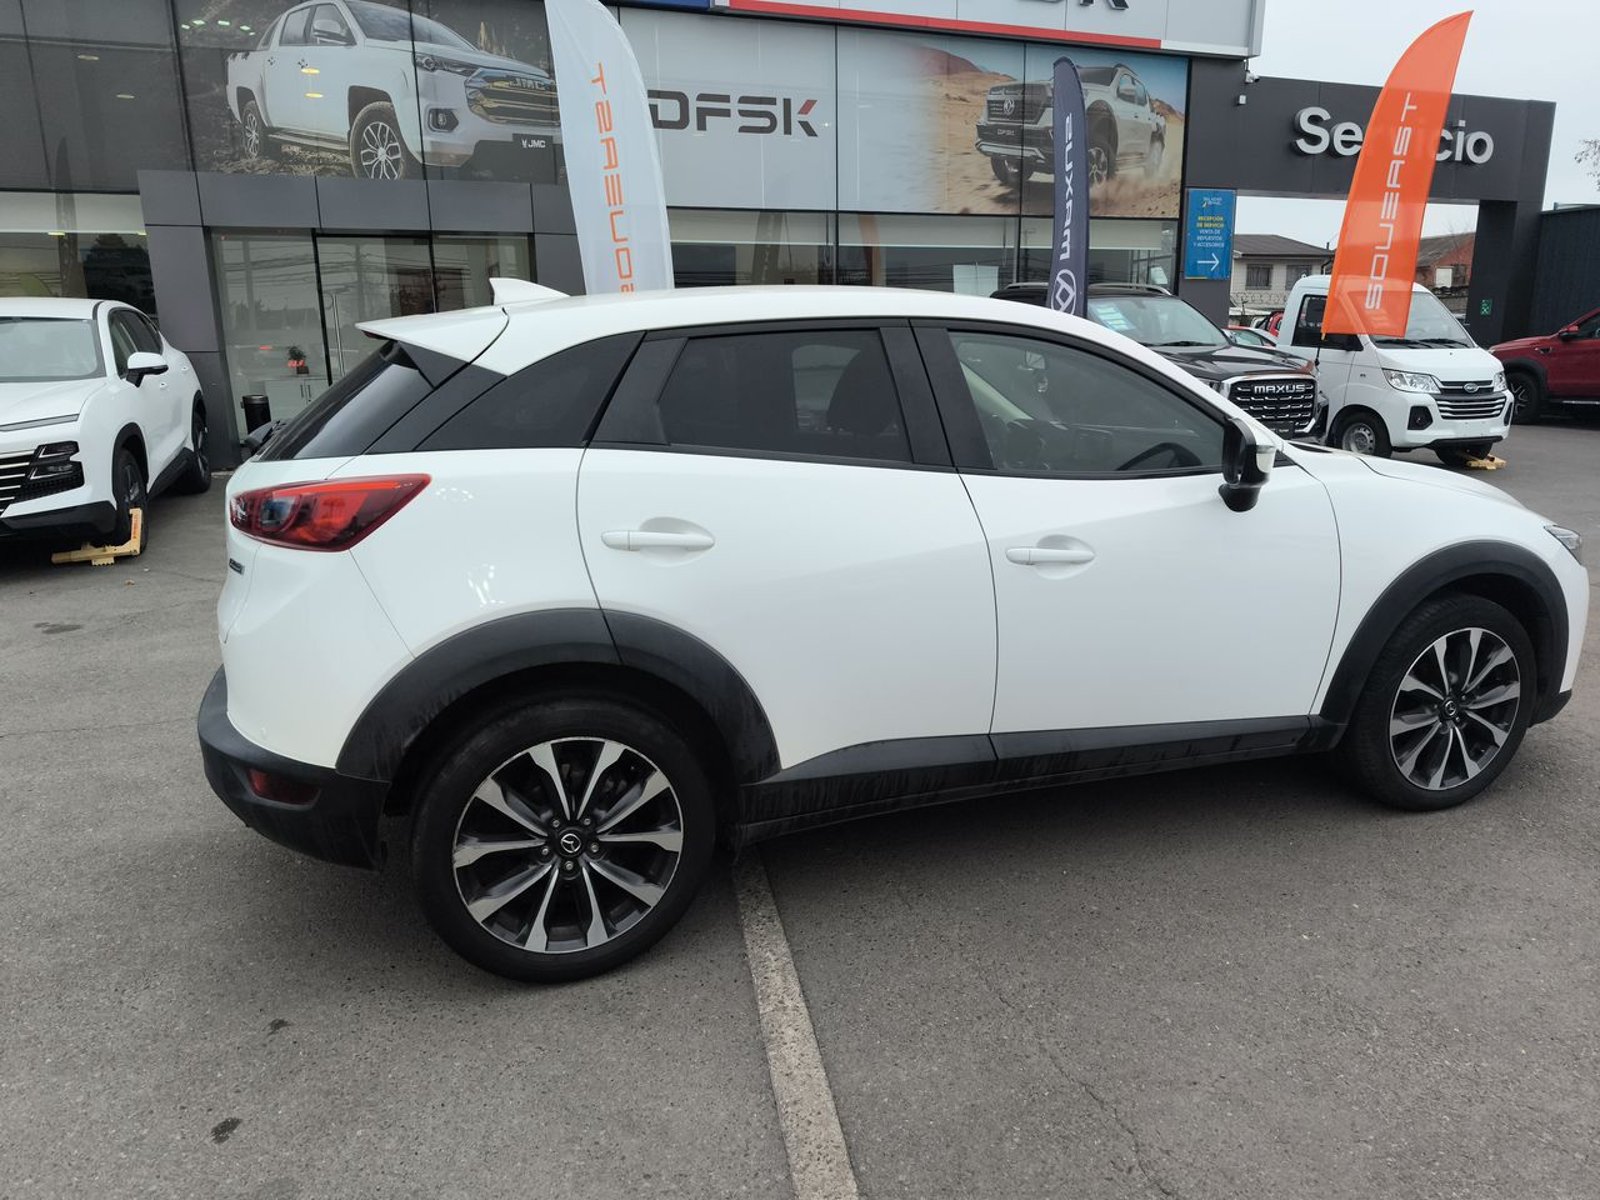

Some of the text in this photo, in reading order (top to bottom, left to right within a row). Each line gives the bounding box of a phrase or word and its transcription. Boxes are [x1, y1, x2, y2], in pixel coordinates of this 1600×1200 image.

[647, 90, 818, 137] DFSK
[1294, 106, 1494, 164] Secio
[527, 139, 546, 148] JMC
[1364, 92, 1417, 310] SOUEAST
[1254, 384, 1306, 394] MAXUS
